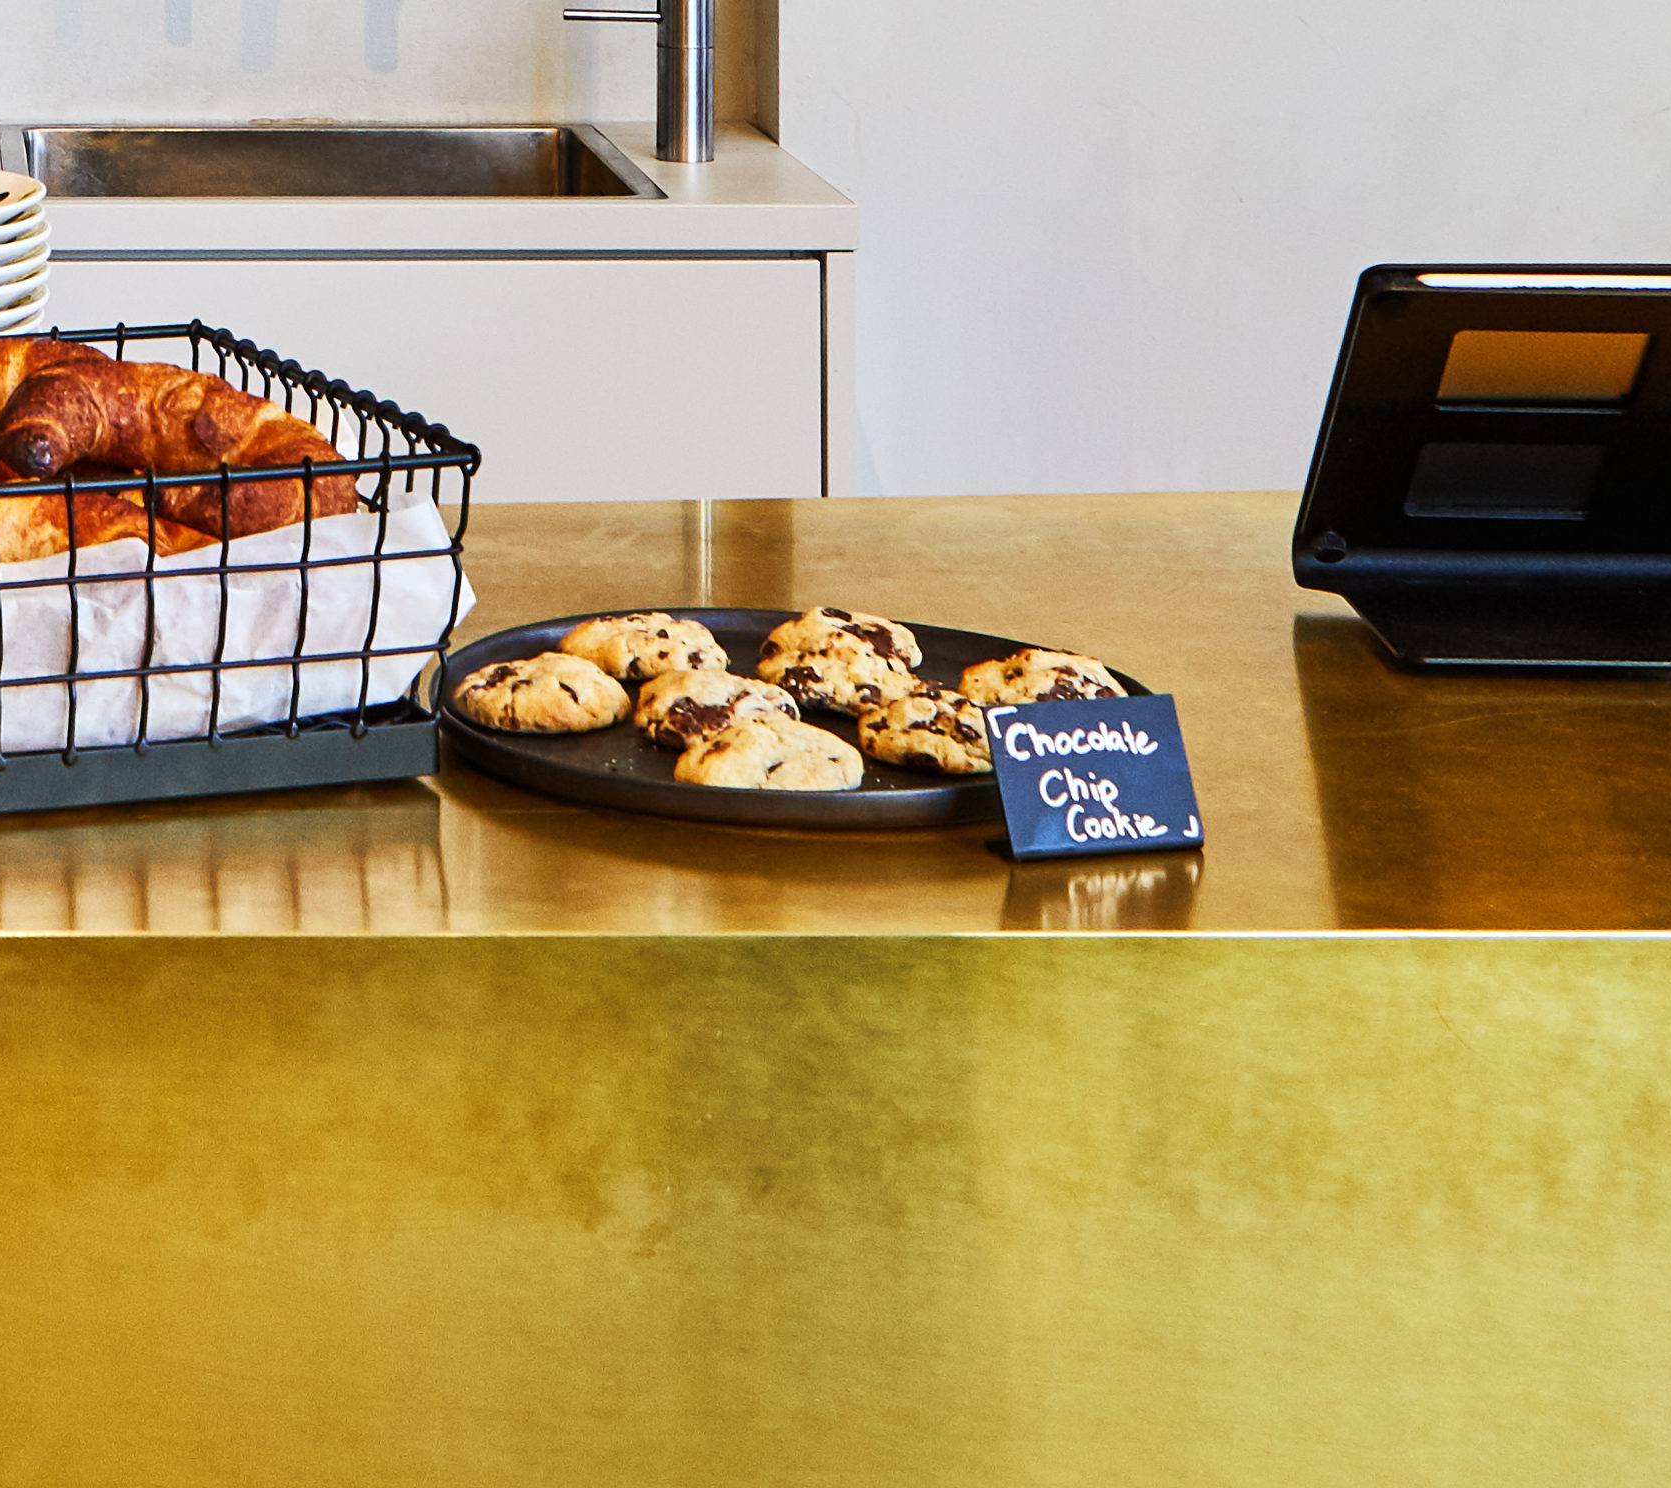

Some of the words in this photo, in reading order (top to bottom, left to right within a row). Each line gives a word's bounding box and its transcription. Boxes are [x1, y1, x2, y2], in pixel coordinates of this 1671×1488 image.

[1005, 720, 1158, 762] Chocolate
[1038, 767, 1119, 813] Chip
[1066, 803, 1169, 843] Cookie
